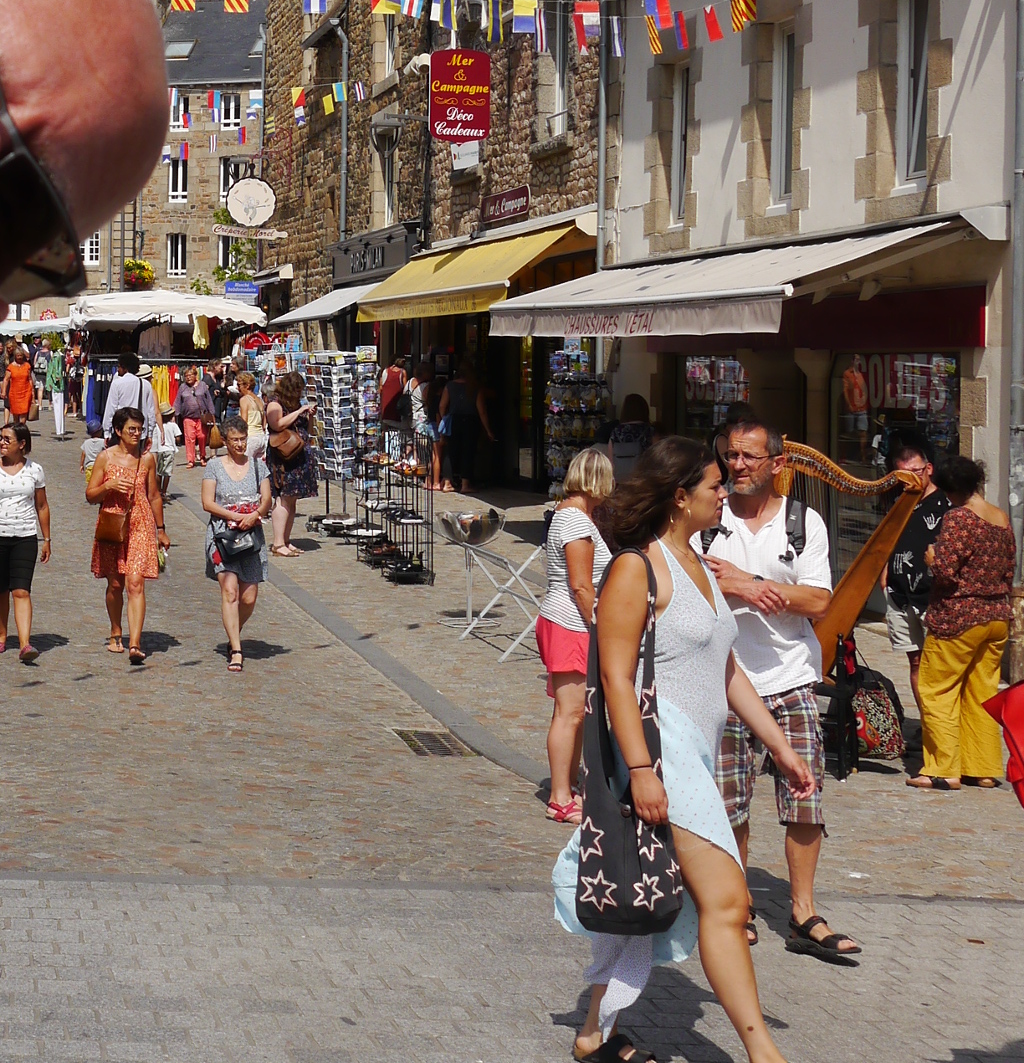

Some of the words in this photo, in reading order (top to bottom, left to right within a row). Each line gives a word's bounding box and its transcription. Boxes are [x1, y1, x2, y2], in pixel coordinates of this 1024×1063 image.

[446, 54, 475, 67] Mer
[454, 69, 467, 81] &
[431, 80, 490, 94] Campagne
[446, 106, 475, 122] Déco
[434, 121, 486, 138] Cadeaux
[500, 195, 527, 215] Campagne
[564, 315, 620, 335] CHAUSSURES
[852, 353, 948, 413] SOLDES
